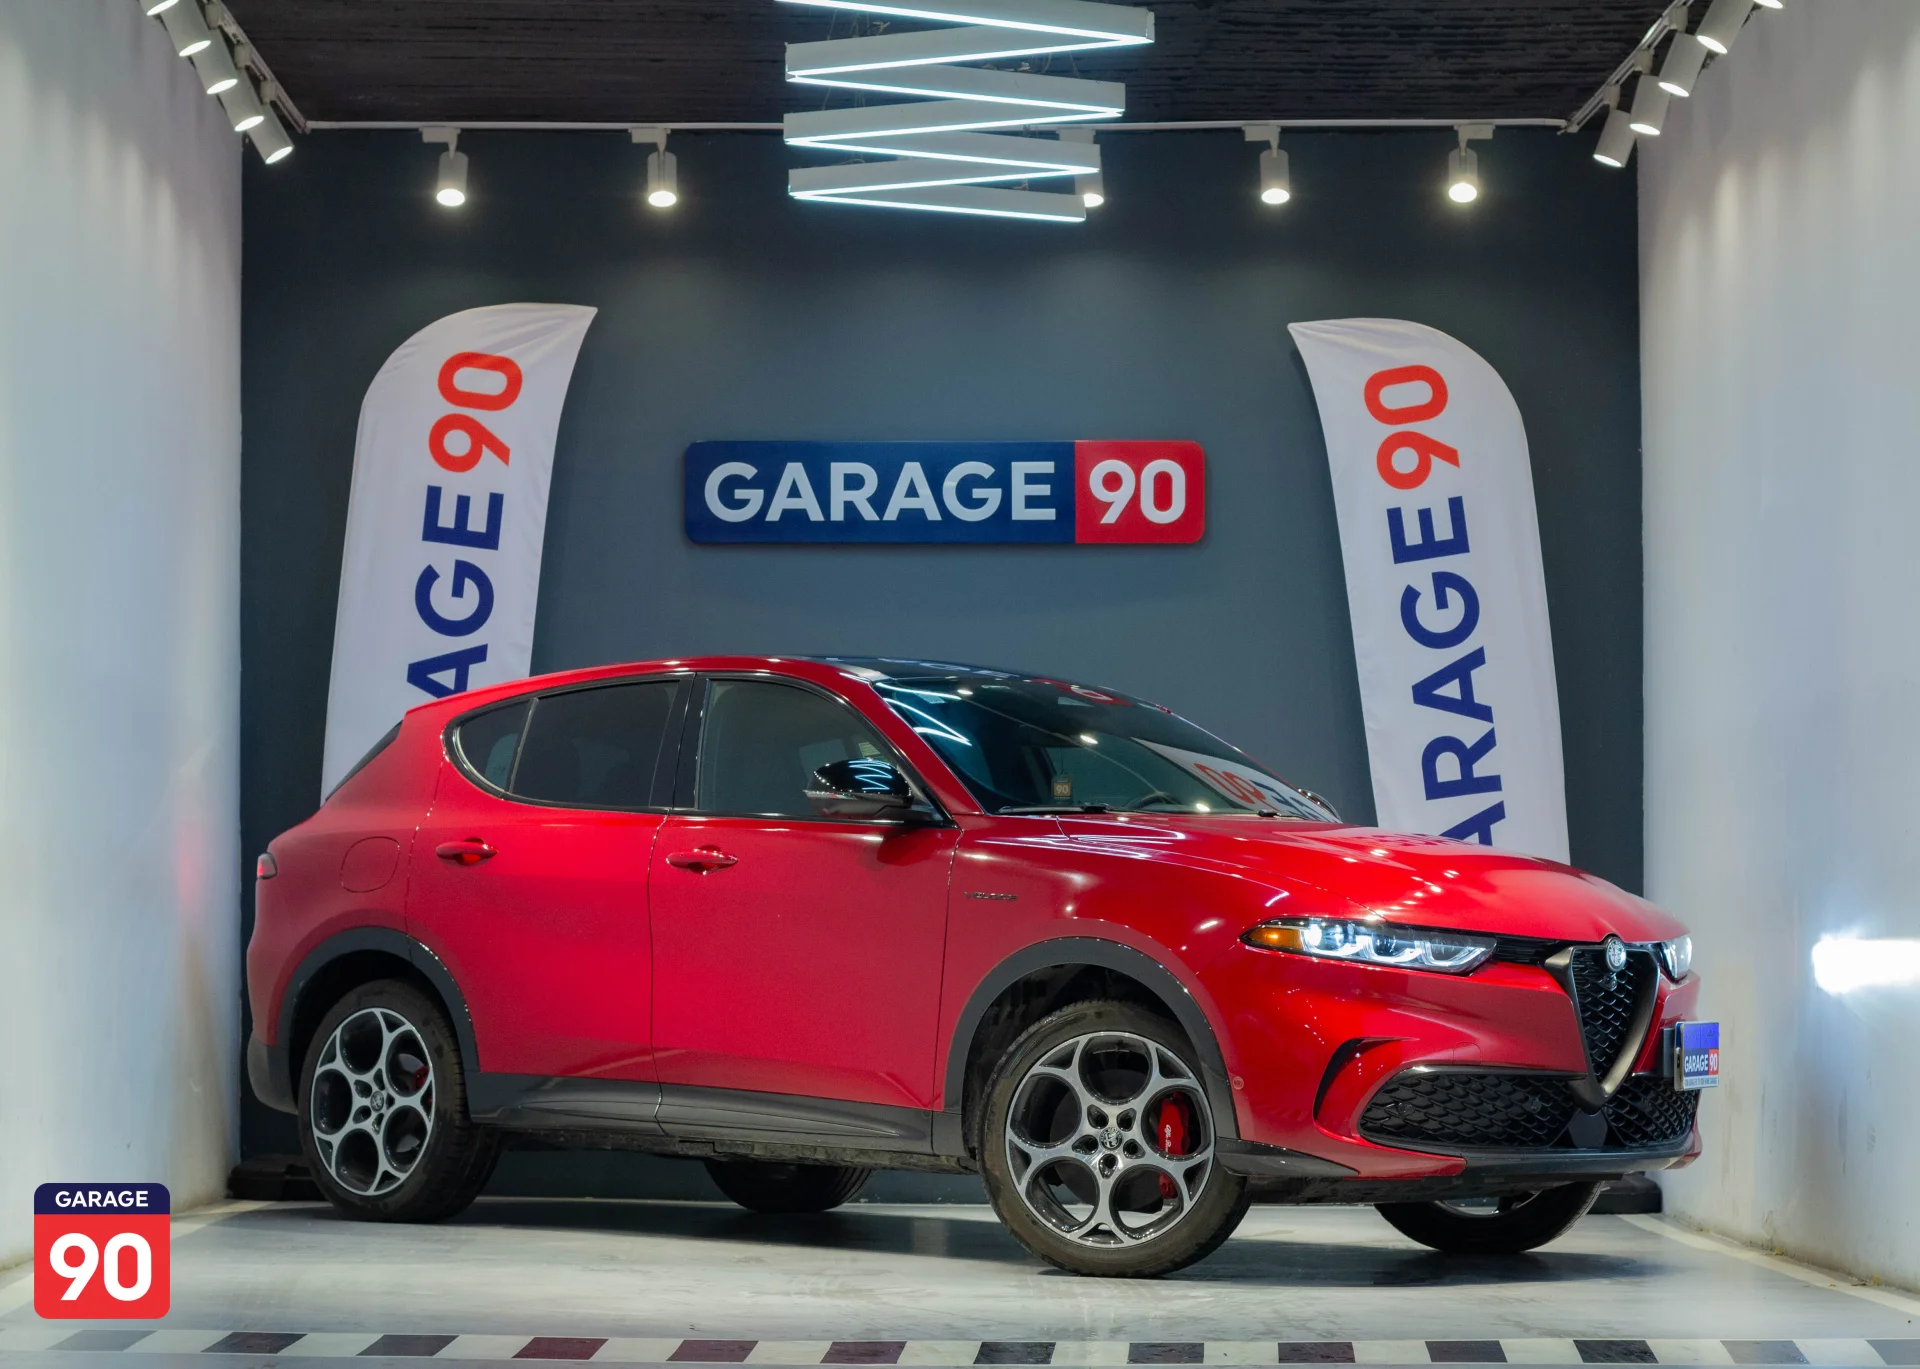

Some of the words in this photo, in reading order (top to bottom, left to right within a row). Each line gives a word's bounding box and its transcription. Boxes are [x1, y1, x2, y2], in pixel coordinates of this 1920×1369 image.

[428, 351, 523, 473] 90
[1363, 364, 1460, 490] 90
[704, 461, 1056, 522] GARAGE
[1089, 459, 1186, 524] 90
[1684, 1054, 1708, 1072] GARAGE
[1709, 1053, 1718, 1071] 90
